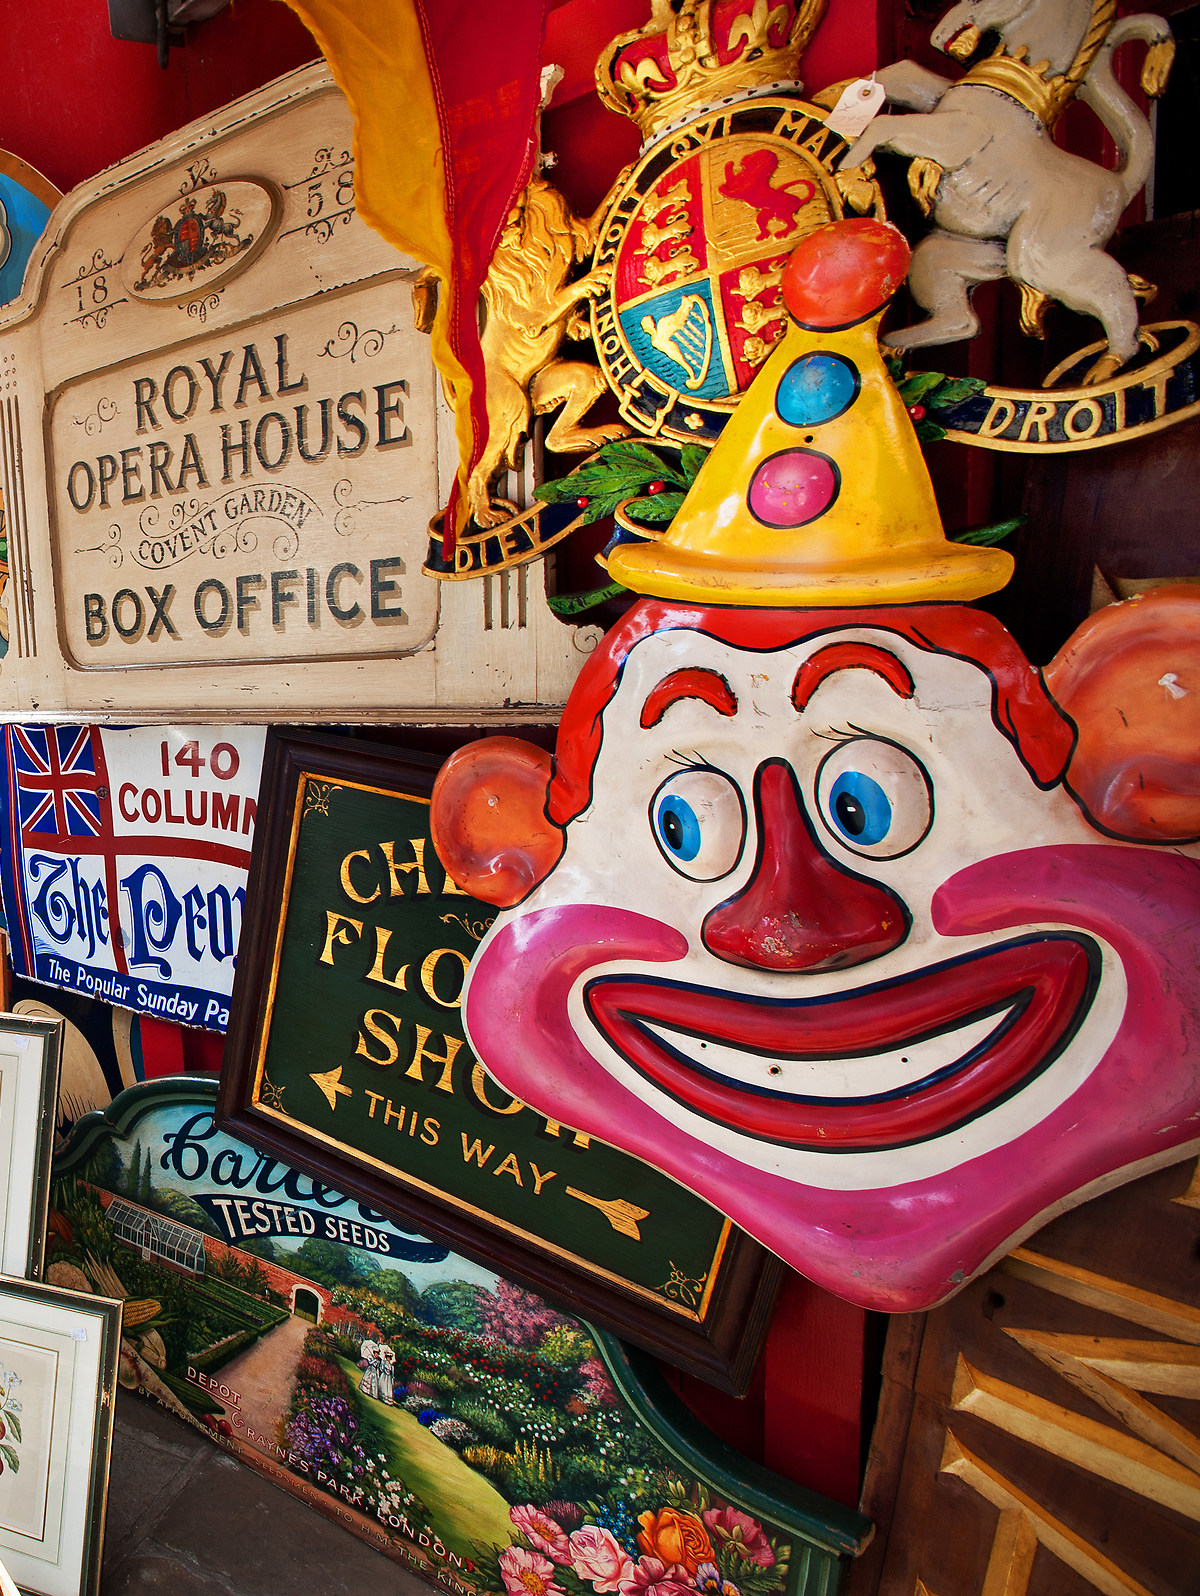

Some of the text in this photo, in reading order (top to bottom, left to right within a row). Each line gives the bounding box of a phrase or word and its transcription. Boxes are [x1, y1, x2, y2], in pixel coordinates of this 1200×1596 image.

[774, 110, 849, 174] MAL
[73, 274, 110, 313] 18
[132, 333, 310, 437] ROYAL
[979, 375, 1176, 445] DROIT
[66, 379, 414, 515] OPERA HOUSE
[139, 488, 312, 565] COVENT GARDEN
[83, 556, 409, 648] BOX OFFICE
[161, 740, 240, 780] 140
[118, 782, 260, 836] COLUMN
[28, 853, 110, 959] The
[48, 959, 71, 984] The
[76, 966, 131, 1001] Popular
[136, 984, 199, 1021] Sunday
[364, 1088, 558, 1196] THIS WAY
[212, 1197, 391, 1253] TESTED SEEDS
[187, 1366, 241, 1404] DEPOT
[138, 1385, 151, 1398] BY
[157, 1398, 245, 1454] APPOINTMENT
[254, 1457, 319, 1500] SEEDSMEN
[335, 1506, 353, 1523] TO
[398, 1545, 428, 1571] THE
[246, 1427, 309, 1473] RAYNES
